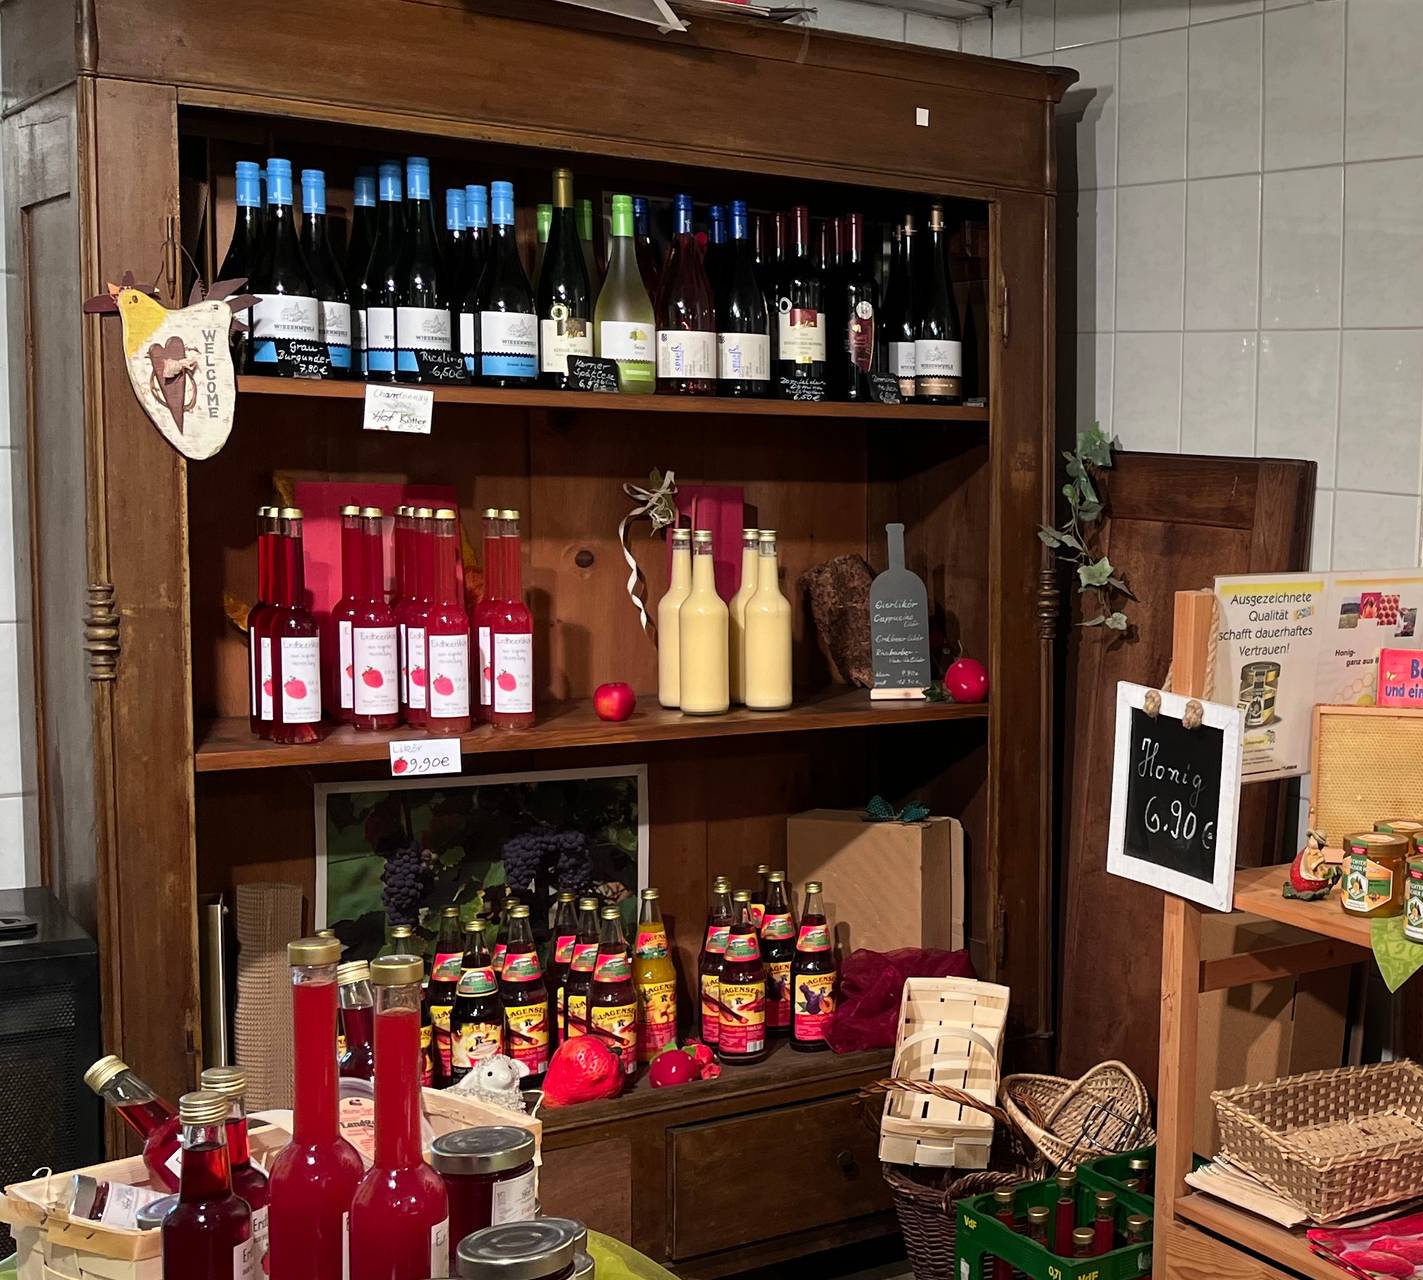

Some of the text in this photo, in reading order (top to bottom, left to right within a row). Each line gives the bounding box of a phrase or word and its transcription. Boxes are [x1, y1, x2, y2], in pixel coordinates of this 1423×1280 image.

[277, 349, 330, 365] Burgunder
[419, 351, 463, 368] Riesling
[202, 330, 219, 418] WELCOME
[1230, 592, 1312, 606] Ausgezeichnete
[1248, 610, 1289, 622] Qualität
[1218, 626, 1313, 641] schafft dauerhaftes
[1239, 643, 1290, 656] Vertrauen!
[1385, 685, 1405, 696] und
[1138, 738, 1208, 808] Honig
